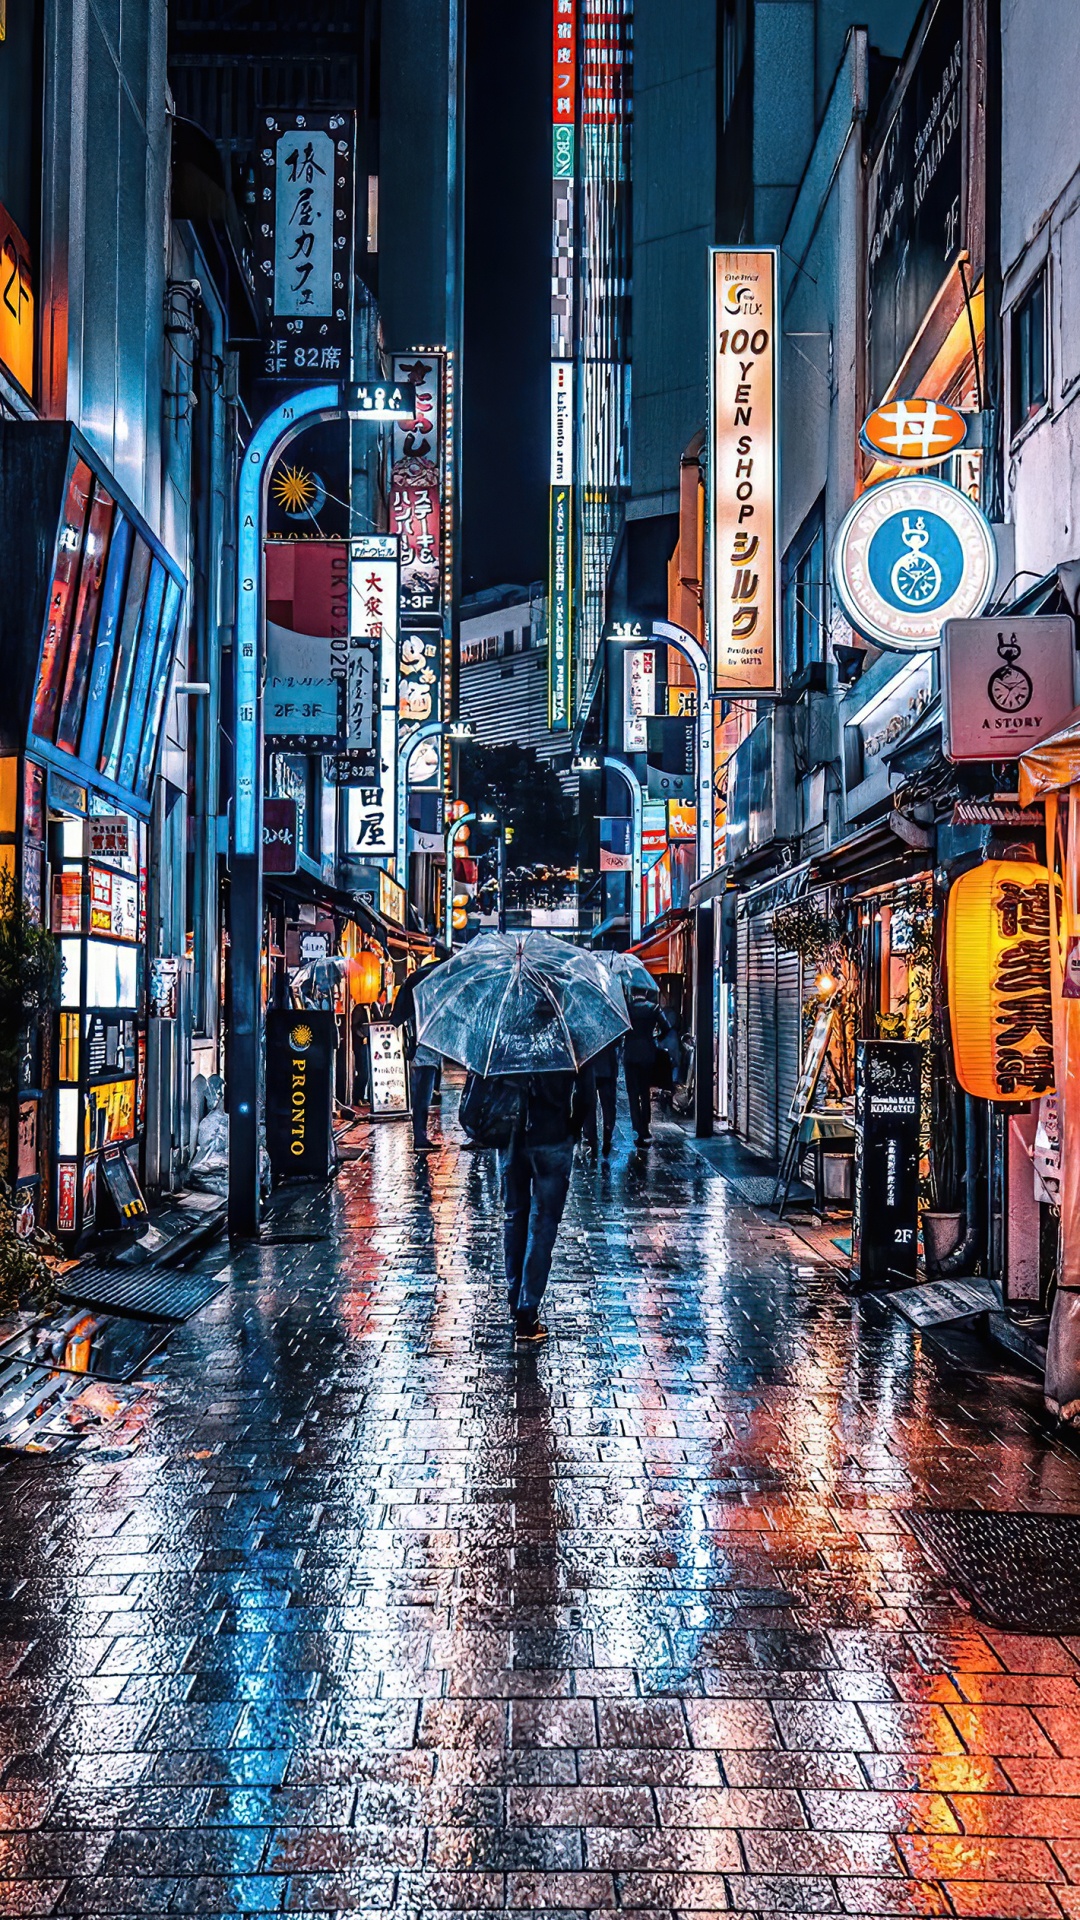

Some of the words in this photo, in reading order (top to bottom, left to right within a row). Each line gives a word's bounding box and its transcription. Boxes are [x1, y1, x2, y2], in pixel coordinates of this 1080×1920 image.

[285, 142, 328, 305] 椿屋カフェ
[719, 329, 769, 355] 100
[294, 346, 341, 370] 82席
[357, 387, 402, 401] MOA
[734, 361, 754, 427] YEN
[735, 435, 754, 524] SHOP
[730, 532, 760, 640] シルク
[982, 719, 990, 729] A
[995, 717, 1043, 728] STORY
[290, 1059, 307, 1156] PRONTO
[870, 1104, 916, 1113] KOMATSU
[894, 1228, 912, 1244] 2F
